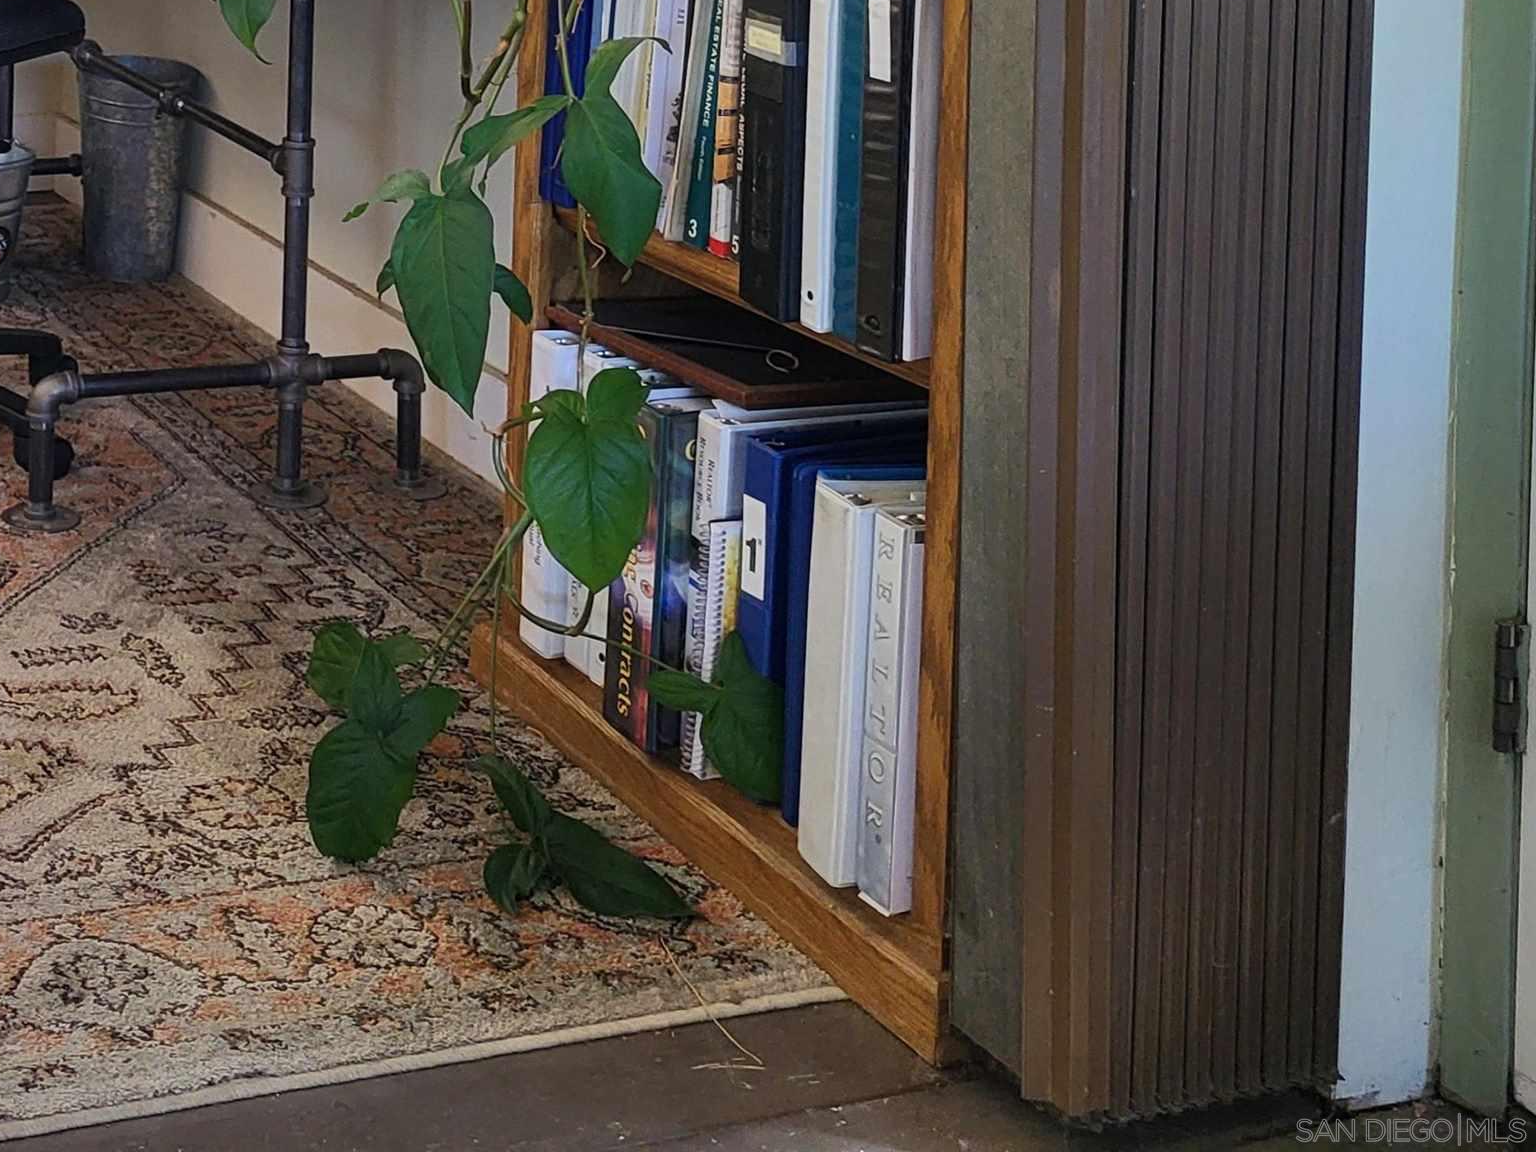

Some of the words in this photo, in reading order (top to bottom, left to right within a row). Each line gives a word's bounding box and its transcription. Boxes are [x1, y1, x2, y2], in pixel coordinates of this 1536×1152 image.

[709, 27, 721, 72] ESTATE
[702, 73, 715, 128] FINANCE
[736, 113, 745, 172] ASPECTS
[688, 219, 698, 239] 3
[731, 235, 740, 255] 5
[617, 593, 640, 718] Conracts
